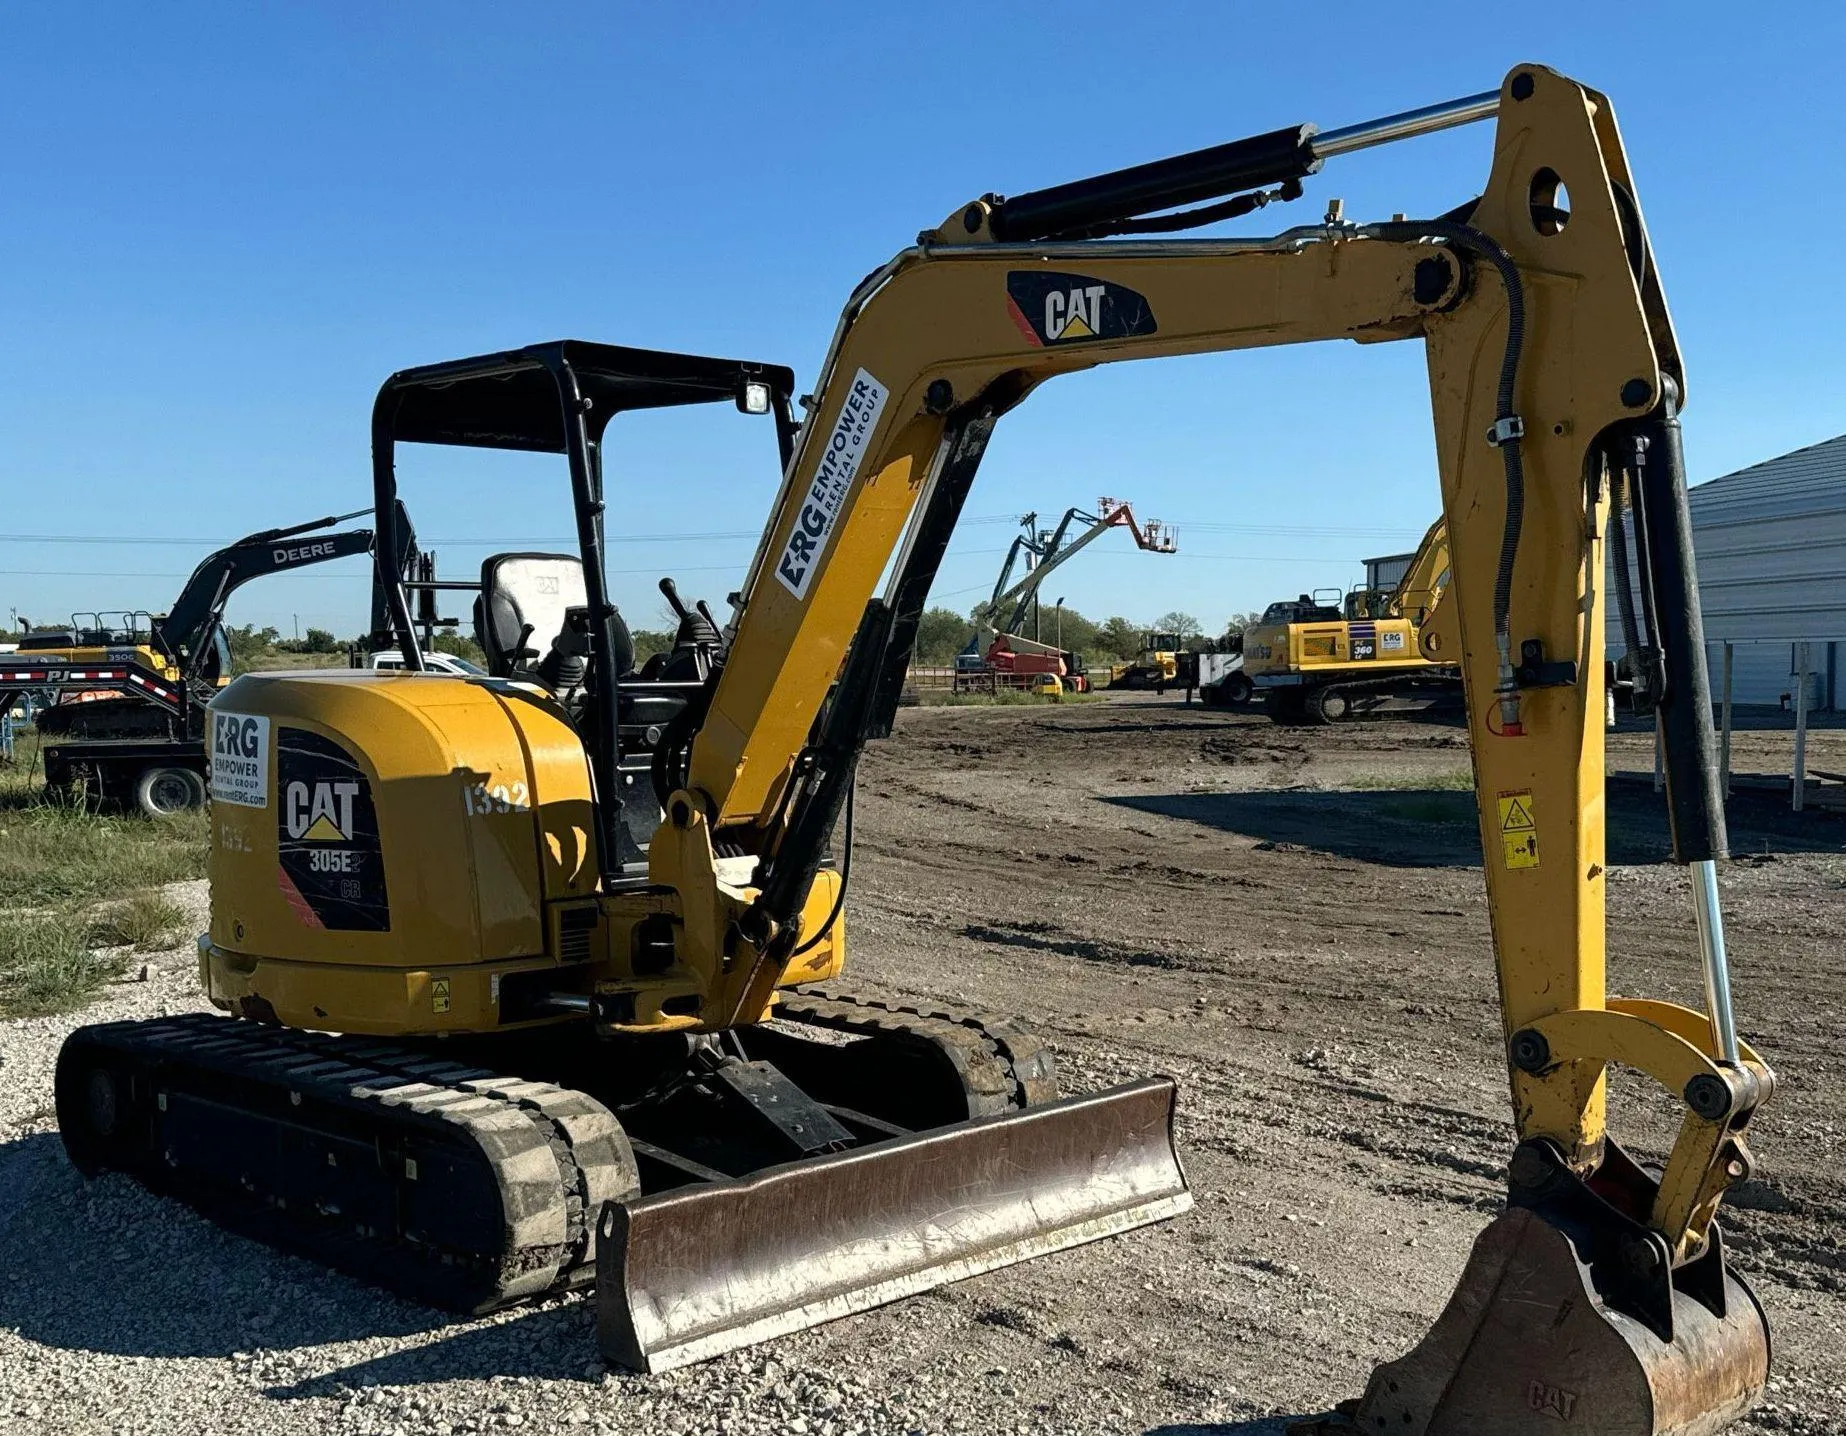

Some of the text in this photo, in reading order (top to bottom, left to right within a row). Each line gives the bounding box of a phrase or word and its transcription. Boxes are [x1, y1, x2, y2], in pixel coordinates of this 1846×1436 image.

[1045, 285, 1106, 340] CAT
[811, 379, 870, 503] EMPOWER
[825, 388, 879, 511] RENTAL GROUP
[273, 541, 336, 564] DEERE
[780, 503, 827, 588] ERG
[1354, 646, 1373, 654] 360
[1383, 633, 1401, 641] ERG
[46, 671, 70, 682] PJ
[215, 715, 259, 759] ERG
[214, 759, 258, 777] EMPOWER
[234, 778, 259, 789] GROUP
[287, 781, 359, 841] CAT
[464, 781, 531, 816] 1392
[340, 879, 361, 898] CR
[1528, 1379, 1578, 1422] CAT
